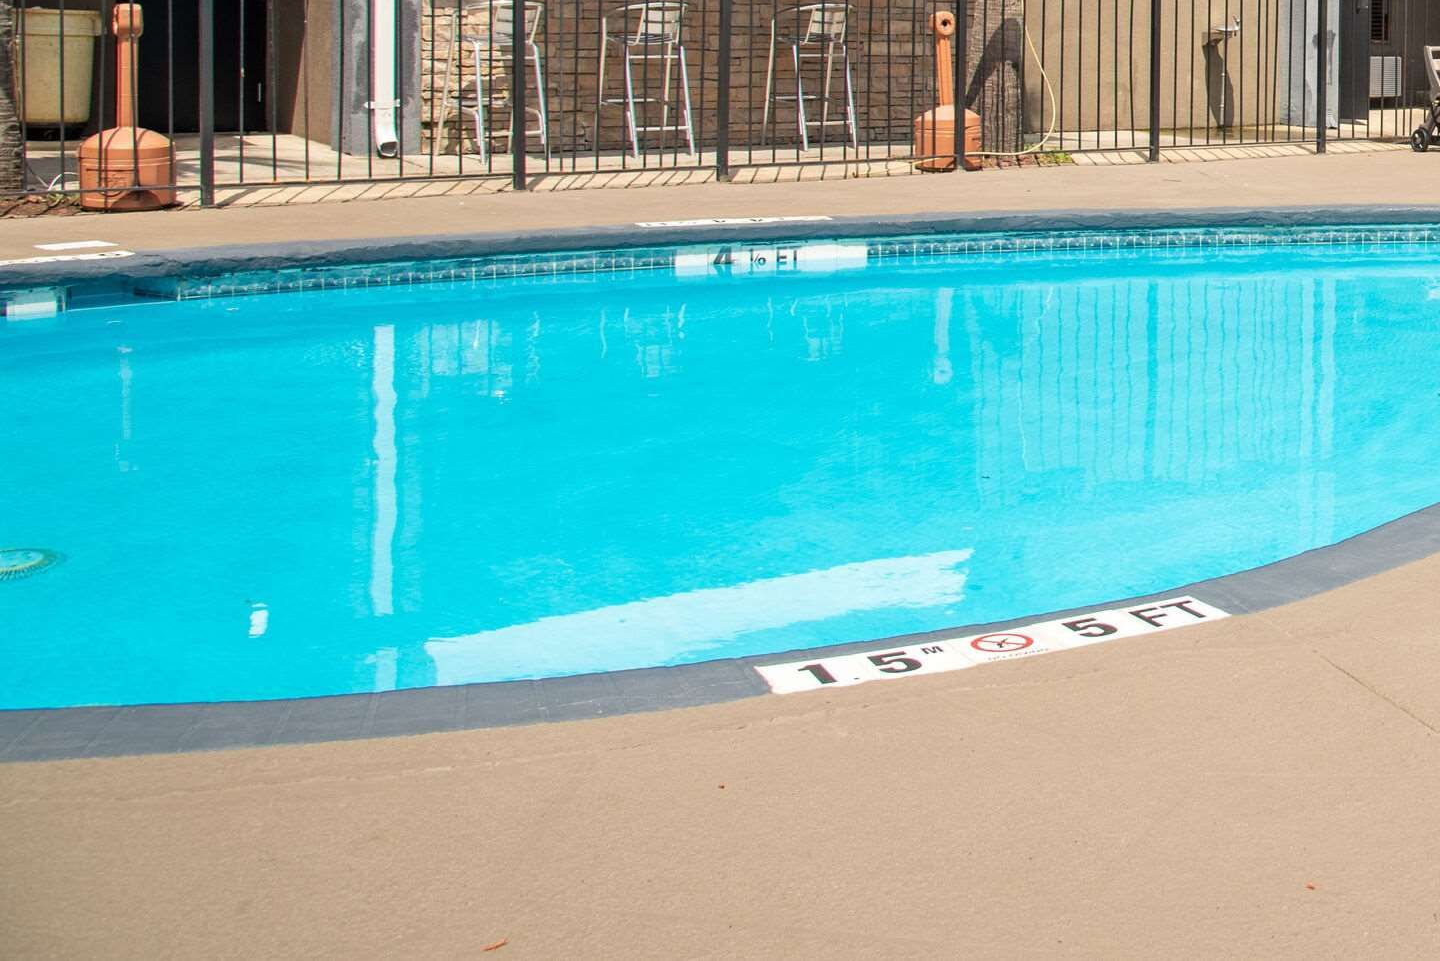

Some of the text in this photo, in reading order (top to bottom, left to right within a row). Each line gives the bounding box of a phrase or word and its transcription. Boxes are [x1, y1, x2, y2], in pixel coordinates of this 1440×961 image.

[713, 246, 735, 265] 4
[1061, 617, 1119, 640] 5
[1127, 599, 1208, 629] FT
